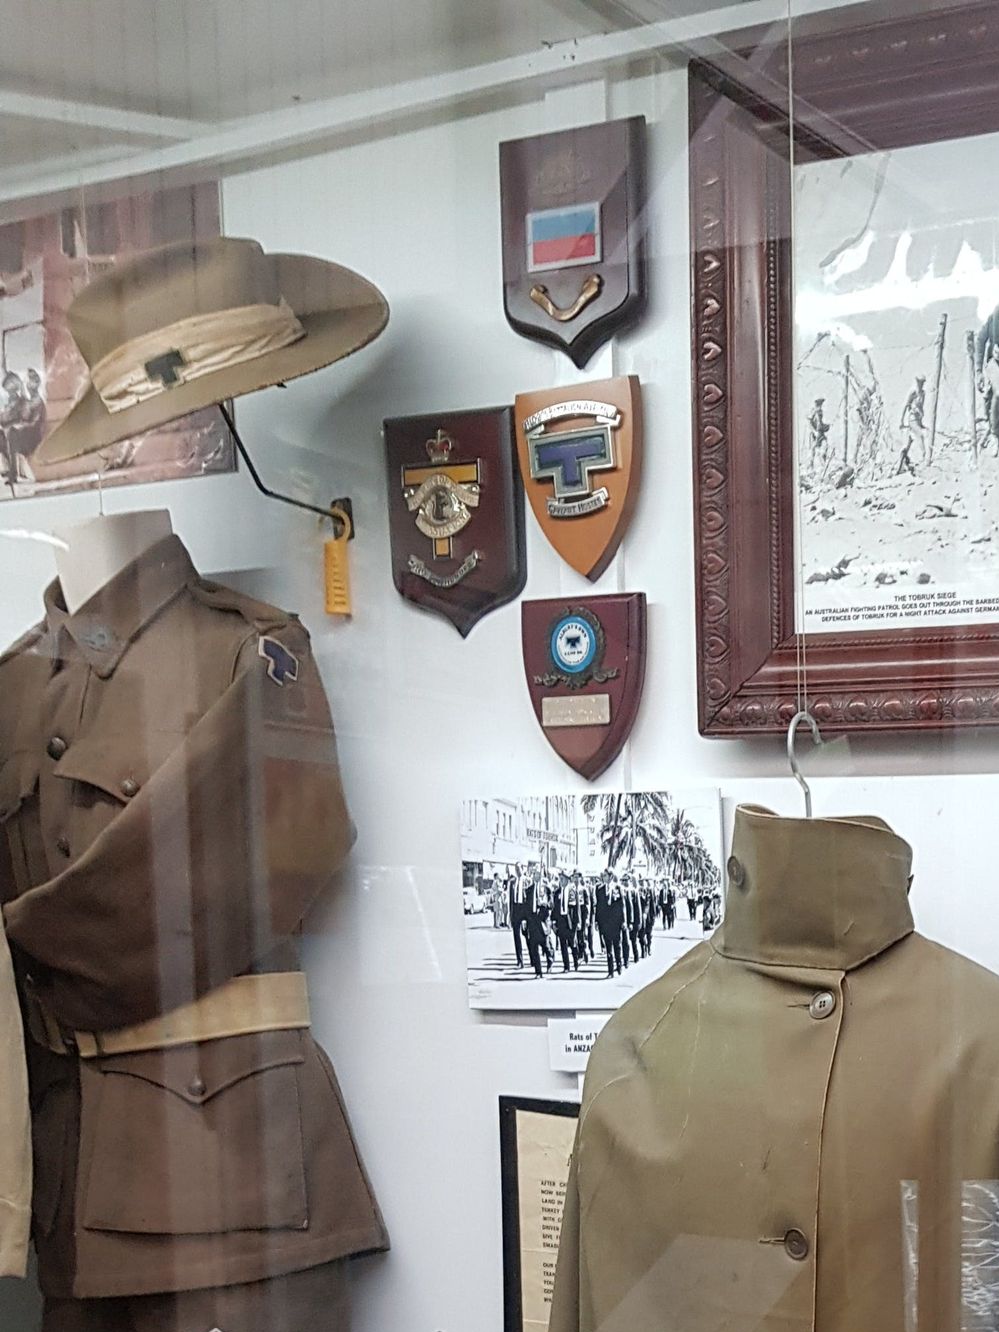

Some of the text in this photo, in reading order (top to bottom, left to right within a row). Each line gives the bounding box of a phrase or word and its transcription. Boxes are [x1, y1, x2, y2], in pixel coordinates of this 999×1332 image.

[908, 593, 935, 601] TOBRUK
[937, 591, 957, 599] SIEGE
[814, 607, 849, 615] AUSTRALIAN
[850, 605, 877, 613] FIGHTING
[933, 600, 961, 608] THROUGH
[975, 597, 999, 605] BARBED
[821, 614, 851, 622] DEFENCES
[923, 608, 946, 616] ATTACK
[569, 1032, 584, 1041] Rats
[585, 1032, 592, 1041] of
[565, 1044, 572, 1053] in
